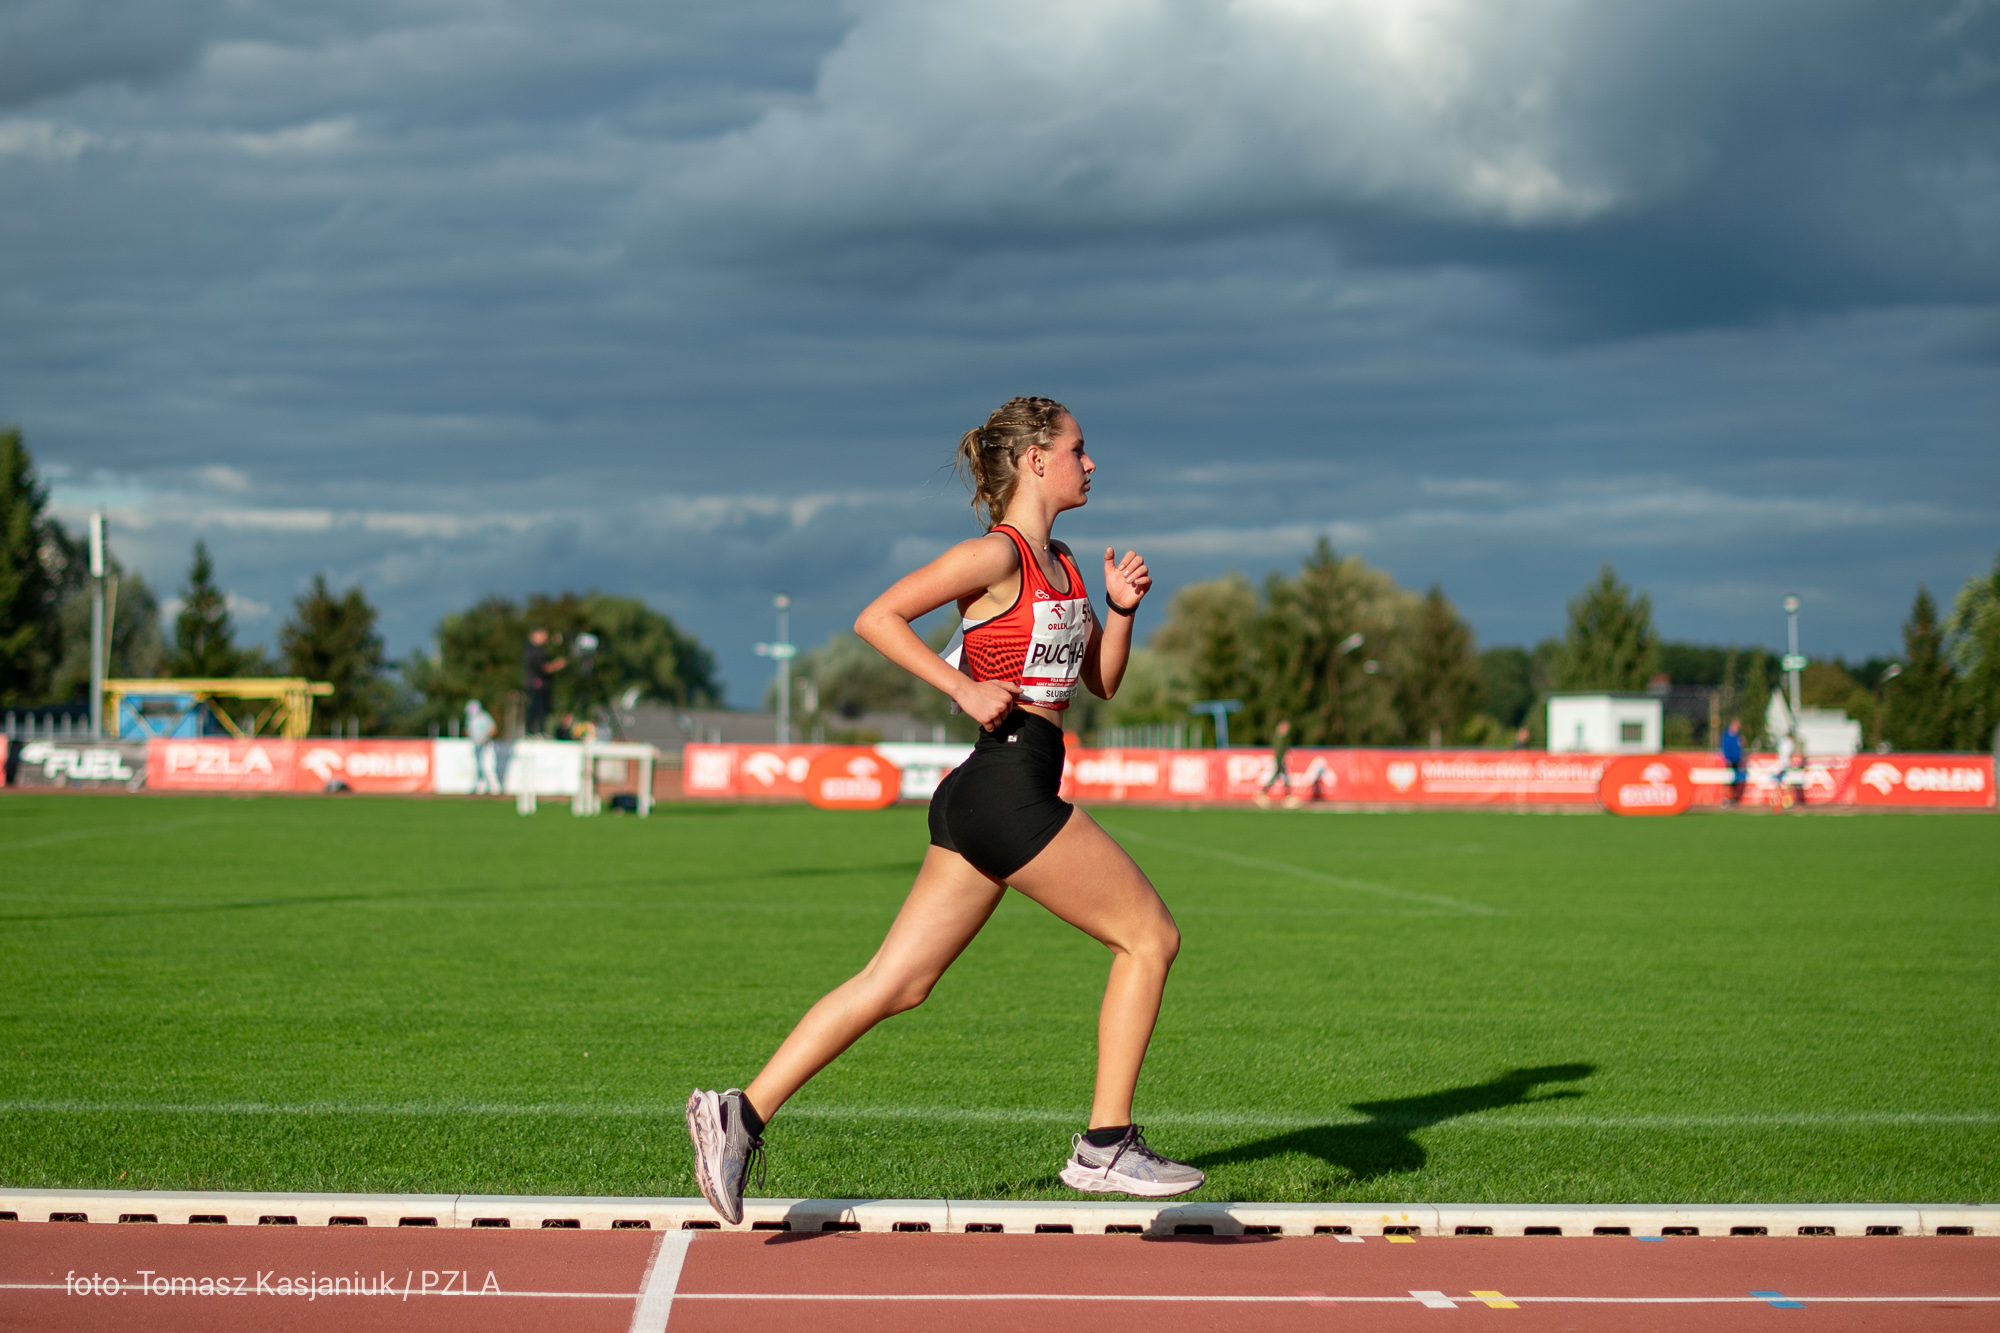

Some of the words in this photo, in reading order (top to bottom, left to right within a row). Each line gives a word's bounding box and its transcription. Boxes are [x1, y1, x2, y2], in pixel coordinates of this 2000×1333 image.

[1047, 622, 1068, 631] ORLEN
[1030, 641, 1084, 665] PUCHA
[165, 743, 273, 775] PZLA
[1904, 766, 1986, 792] ORLEN
